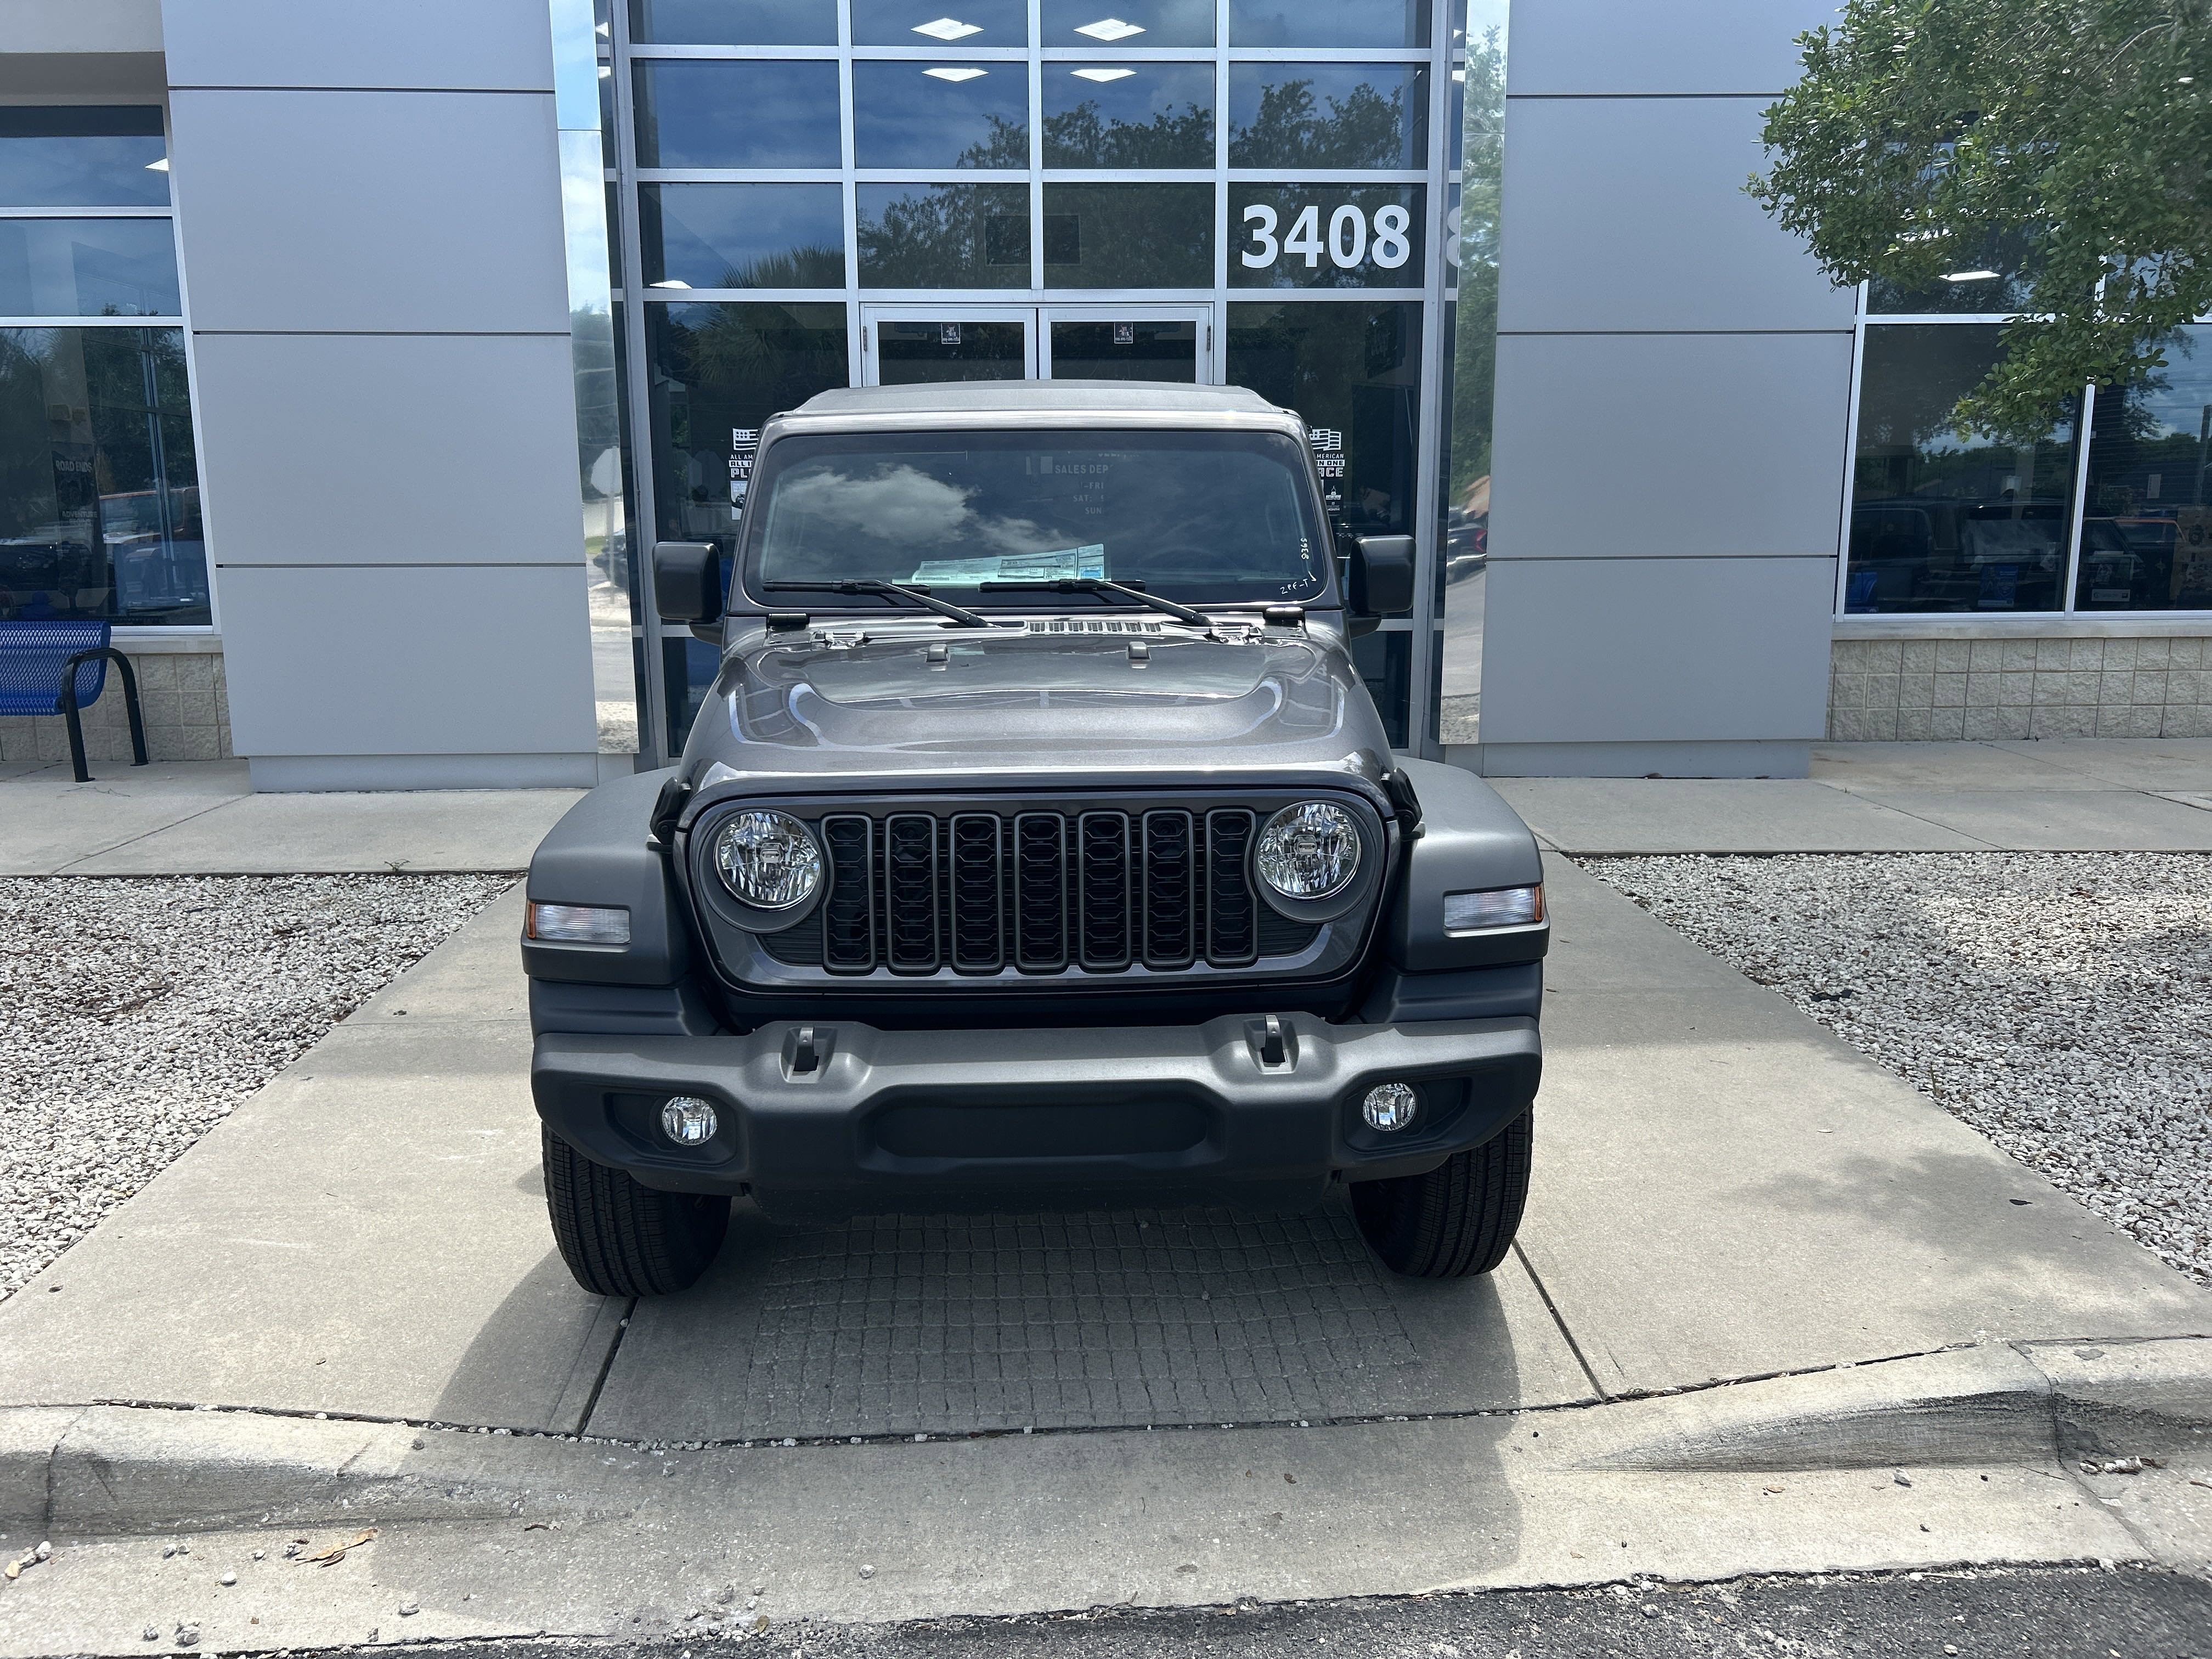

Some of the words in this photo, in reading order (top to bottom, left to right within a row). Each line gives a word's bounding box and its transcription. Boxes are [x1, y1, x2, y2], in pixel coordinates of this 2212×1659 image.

[1242, 204, 1410, 269] 3408
[55, 460, 75, 471] ROAD
[75, 461, 93, 472] ENDS
[1055, 465, 1086, 474] SALES
[1090, 465, 1114, 474] DEP
[1318, 467, 1344, 477] ACE
[1300, 538, 1310, 560] 8365
